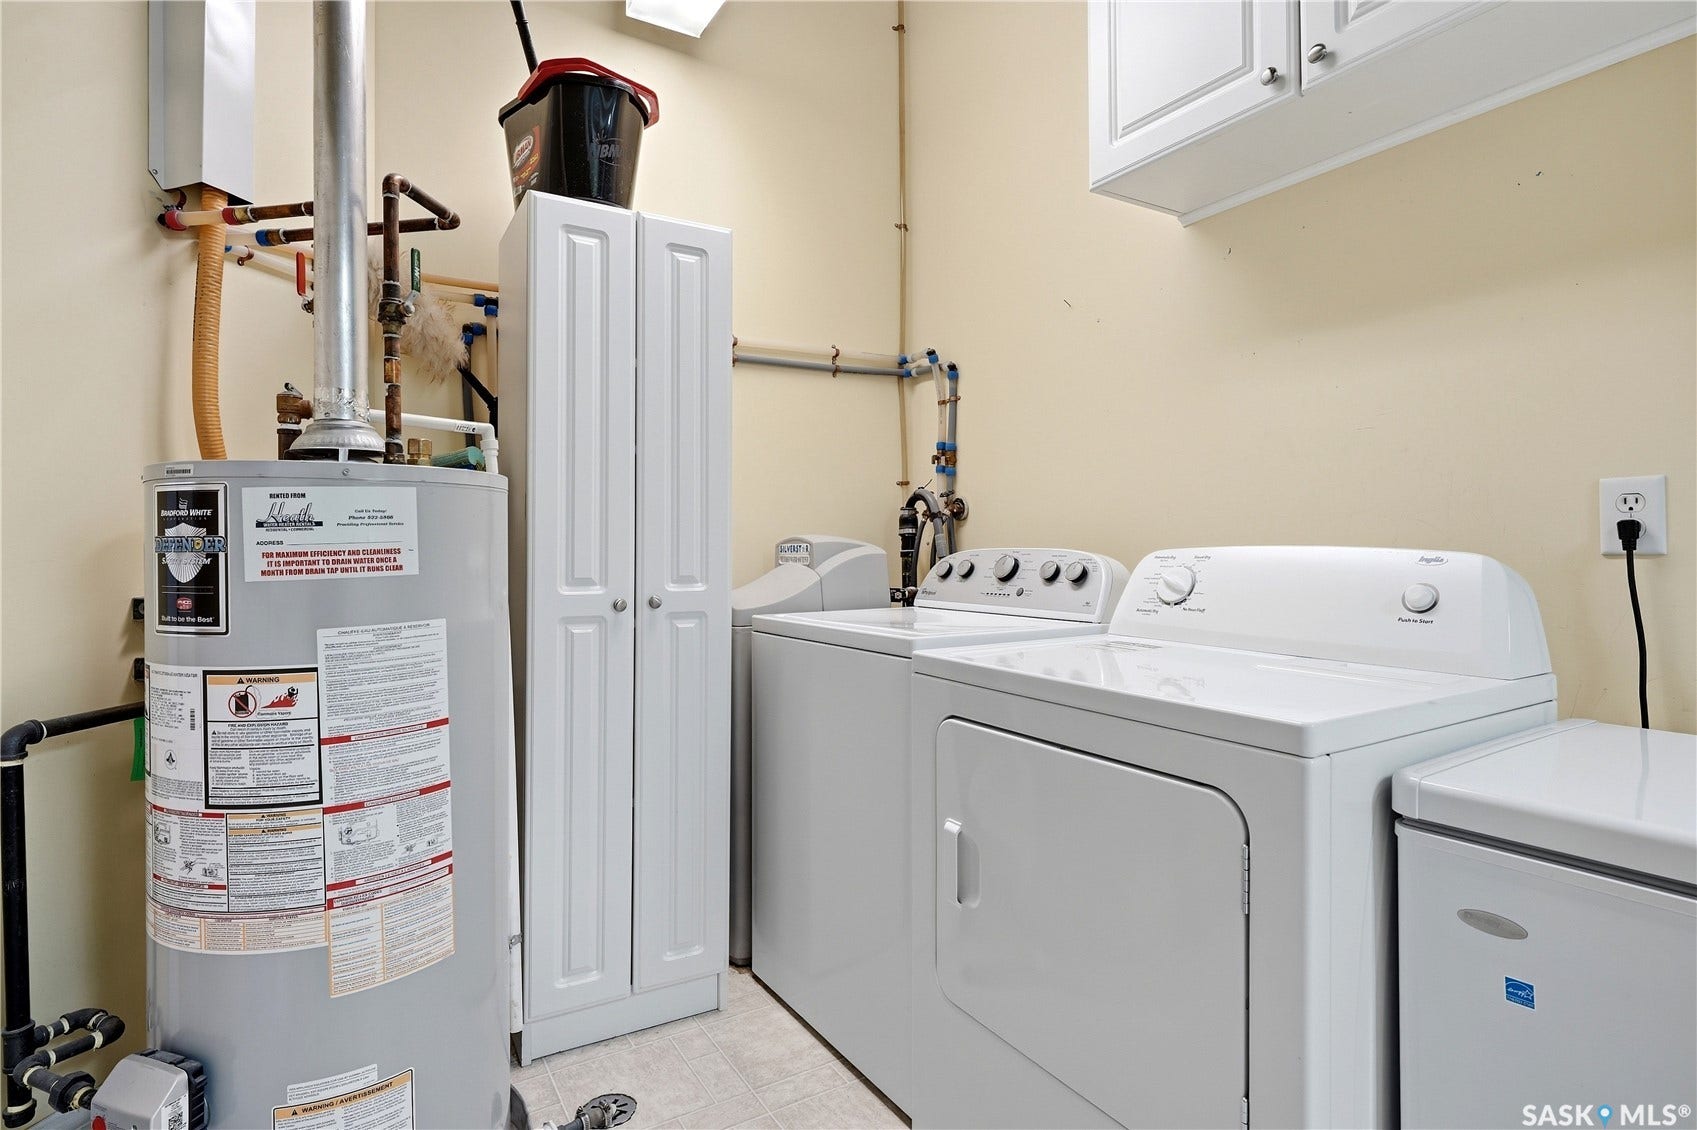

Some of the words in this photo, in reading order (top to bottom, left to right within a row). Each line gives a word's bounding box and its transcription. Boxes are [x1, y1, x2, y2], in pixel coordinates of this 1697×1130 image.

[155, 536, 228, 552] DEFENDER
[302, 1102, 334, 1113] WARNING
[339, 1082, 393, 1104] AVERTISSEMENT
